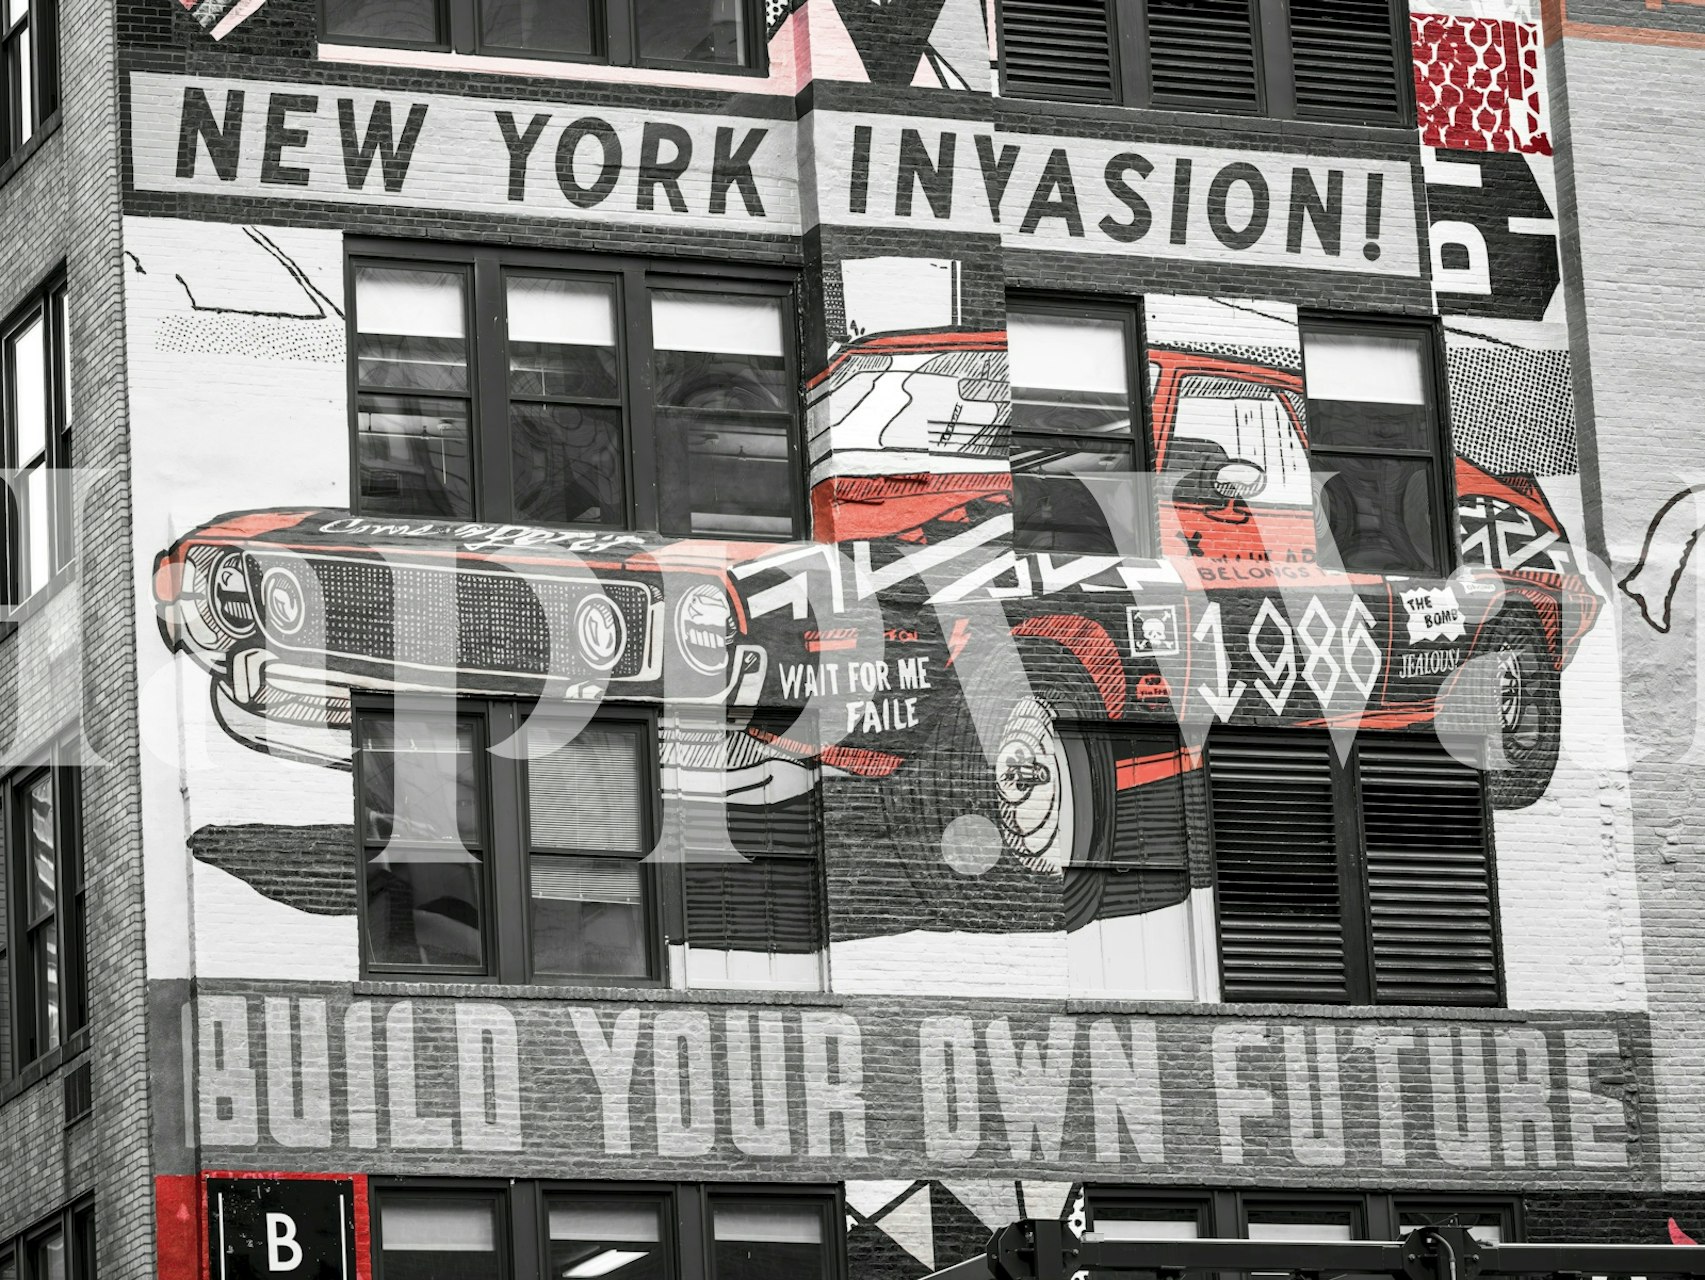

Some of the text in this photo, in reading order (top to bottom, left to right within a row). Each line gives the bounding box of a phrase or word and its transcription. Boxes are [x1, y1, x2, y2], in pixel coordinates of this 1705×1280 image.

[175, 87, 428, 193] NEW
[494, 110, 770, 218] YORK
[850, 127, 1383, 261] INVASION!
[1406, 595, 1433, 611] THE
[1424, 608, 1459, 629] BOMB
[778, 656, 932, 700] WAIT FOR ME
[1192, 593, 1383, 724] 1986
[1398, 648, 1461, 679] JEALOUS!
[845, 697, 920, 734] FAILE
[181, 995, 1630, 1170] BUILD YOUR OWN FUTURE
[266, 1212, 304, 1272] B
